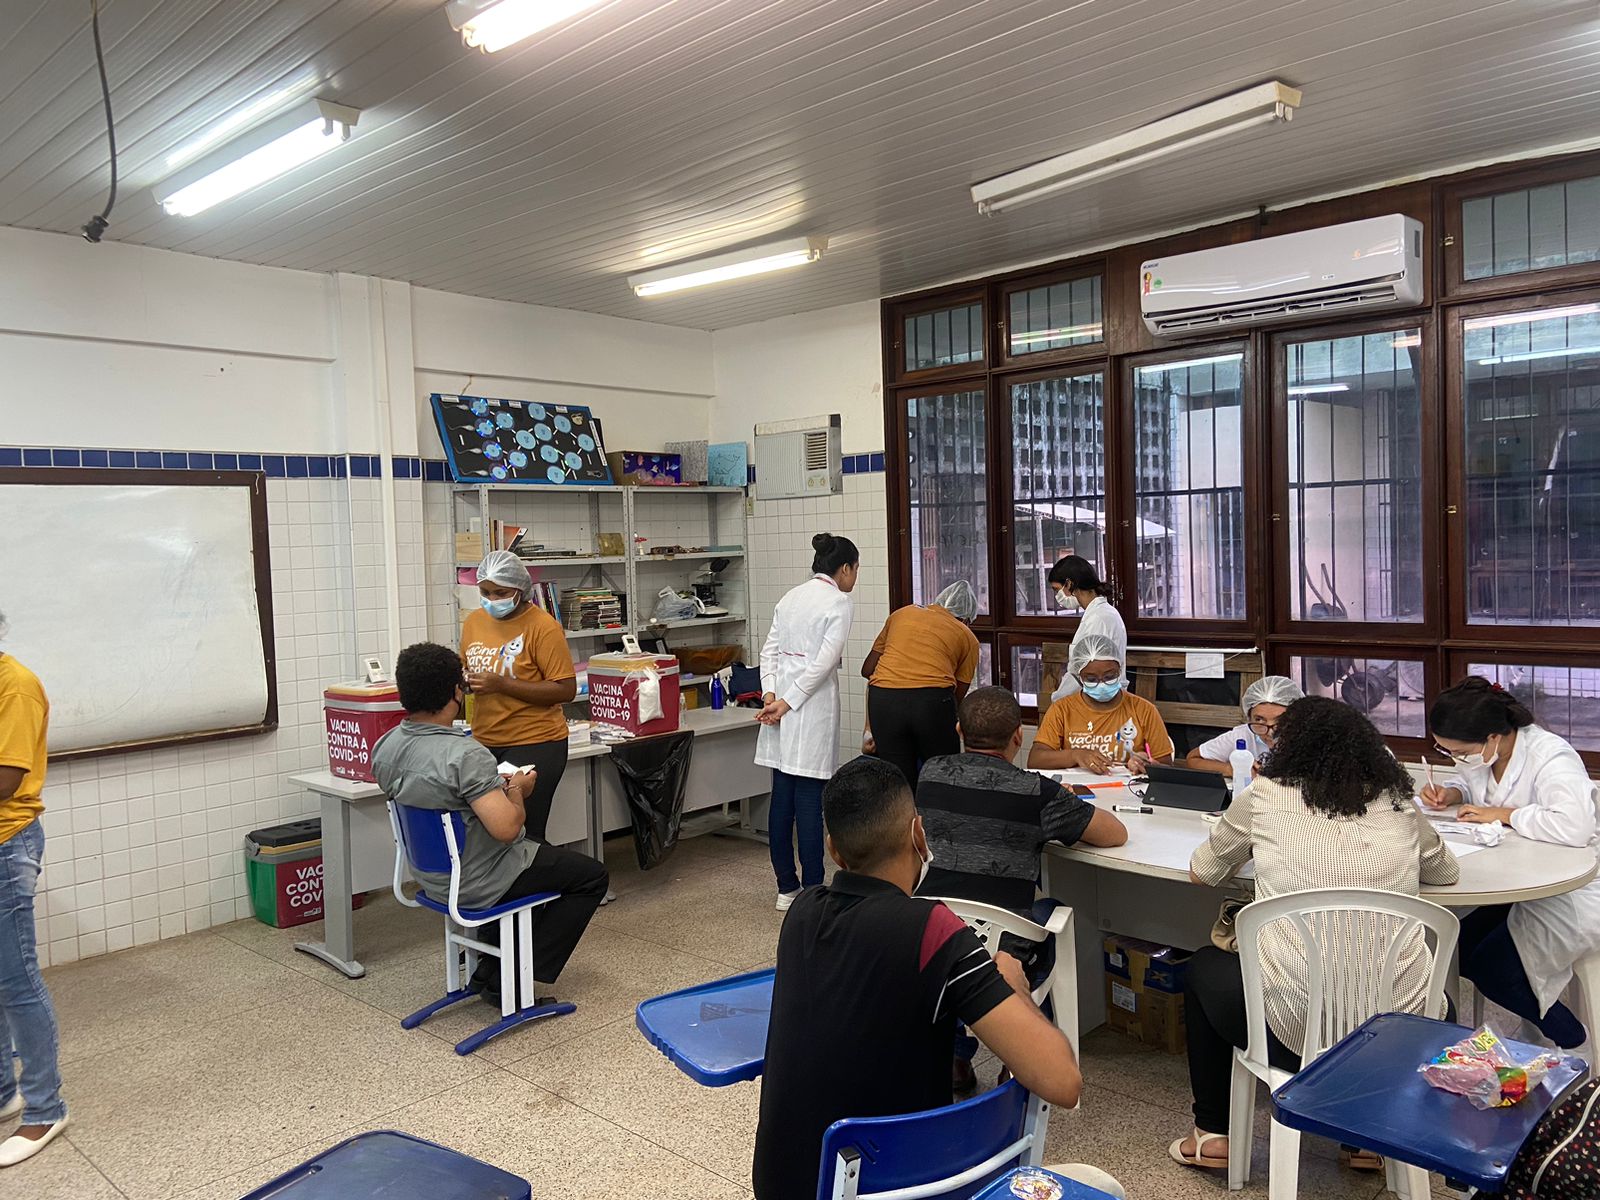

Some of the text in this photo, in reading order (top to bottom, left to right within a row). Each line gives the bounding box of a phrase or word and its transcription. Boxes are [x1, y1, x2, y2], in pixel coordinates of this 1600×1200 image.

[592, 682, 624, 697] VACINA
[589, 694, 630, 709] CONTRA A
[591, 706, 631, 721] COVID-19
[329, 718, 361, 735] VACINA
[327, 731, 368, 750] CONTRA A
[1068, 734, 1113, 745] vacina
[329, 747, 369, 764] COVID-19
[296, 863, 324, 880] VAC
[285, 877, 324, 896] CON
[290, 889, 323, 908] COV
